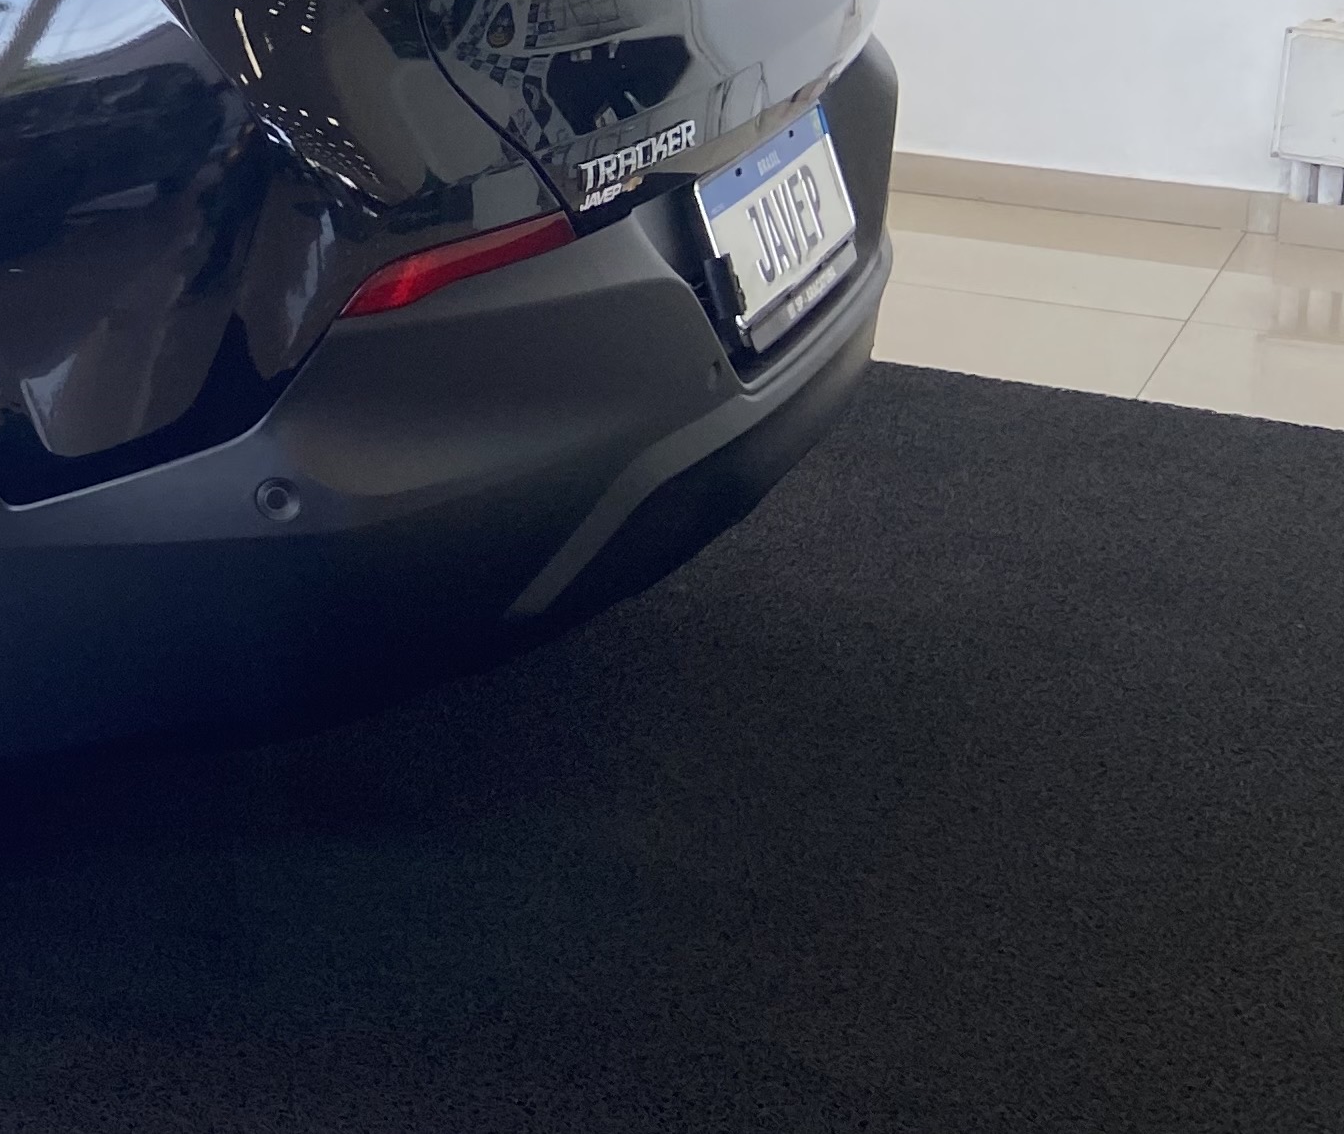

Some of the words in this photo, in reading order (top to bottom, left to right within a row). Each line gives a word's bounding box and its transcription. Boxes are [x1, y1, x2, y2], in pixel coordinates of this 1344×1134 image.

[578, 120, 696, 192] TRACKER
[579, 183, 622, 211] JAVEP
[746, 165, 824, 284] JAVEP
